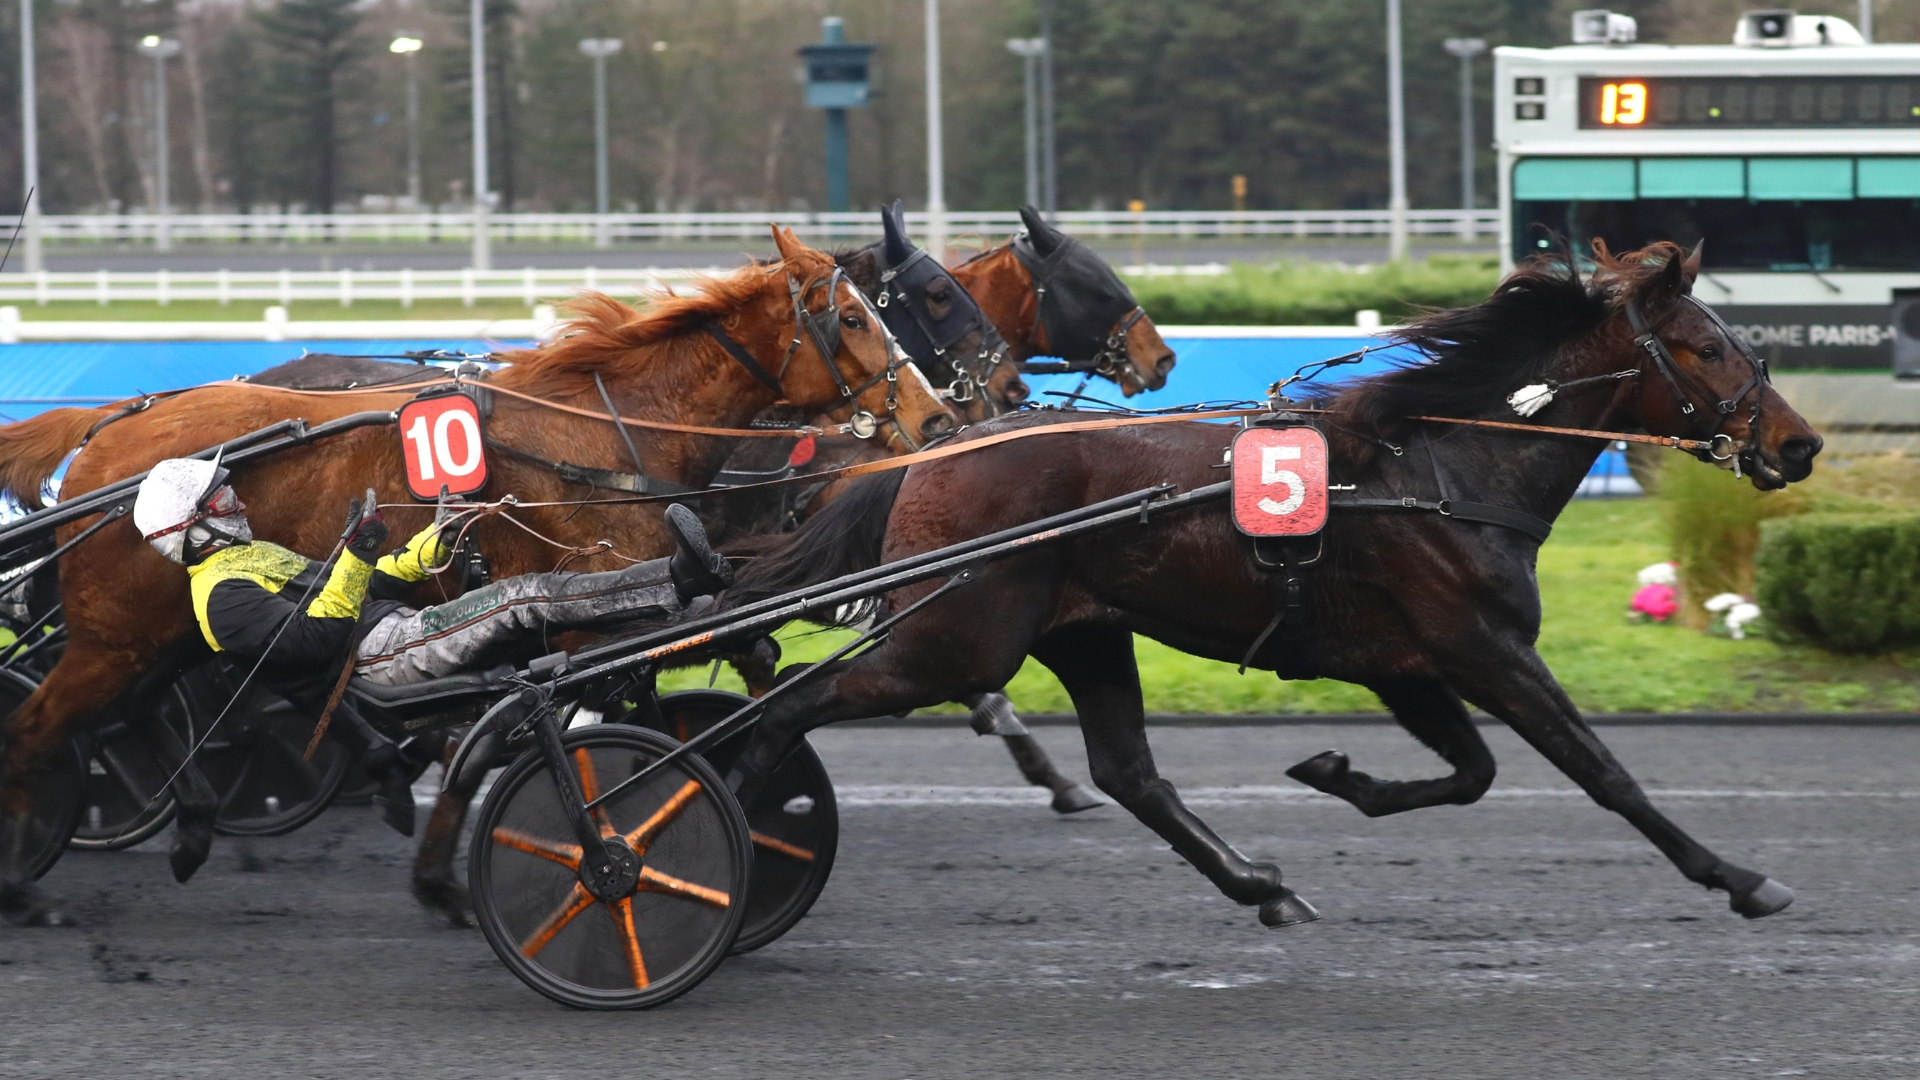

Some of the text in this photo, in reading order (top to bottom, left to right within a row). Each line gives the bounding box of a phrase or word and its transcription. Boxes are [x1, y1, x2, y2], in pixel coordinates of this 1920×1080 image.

[1601, 83, 1647, 124] 13
[406, 409, 482, 480] 10
[1257, 447, 1305, 515] 5
